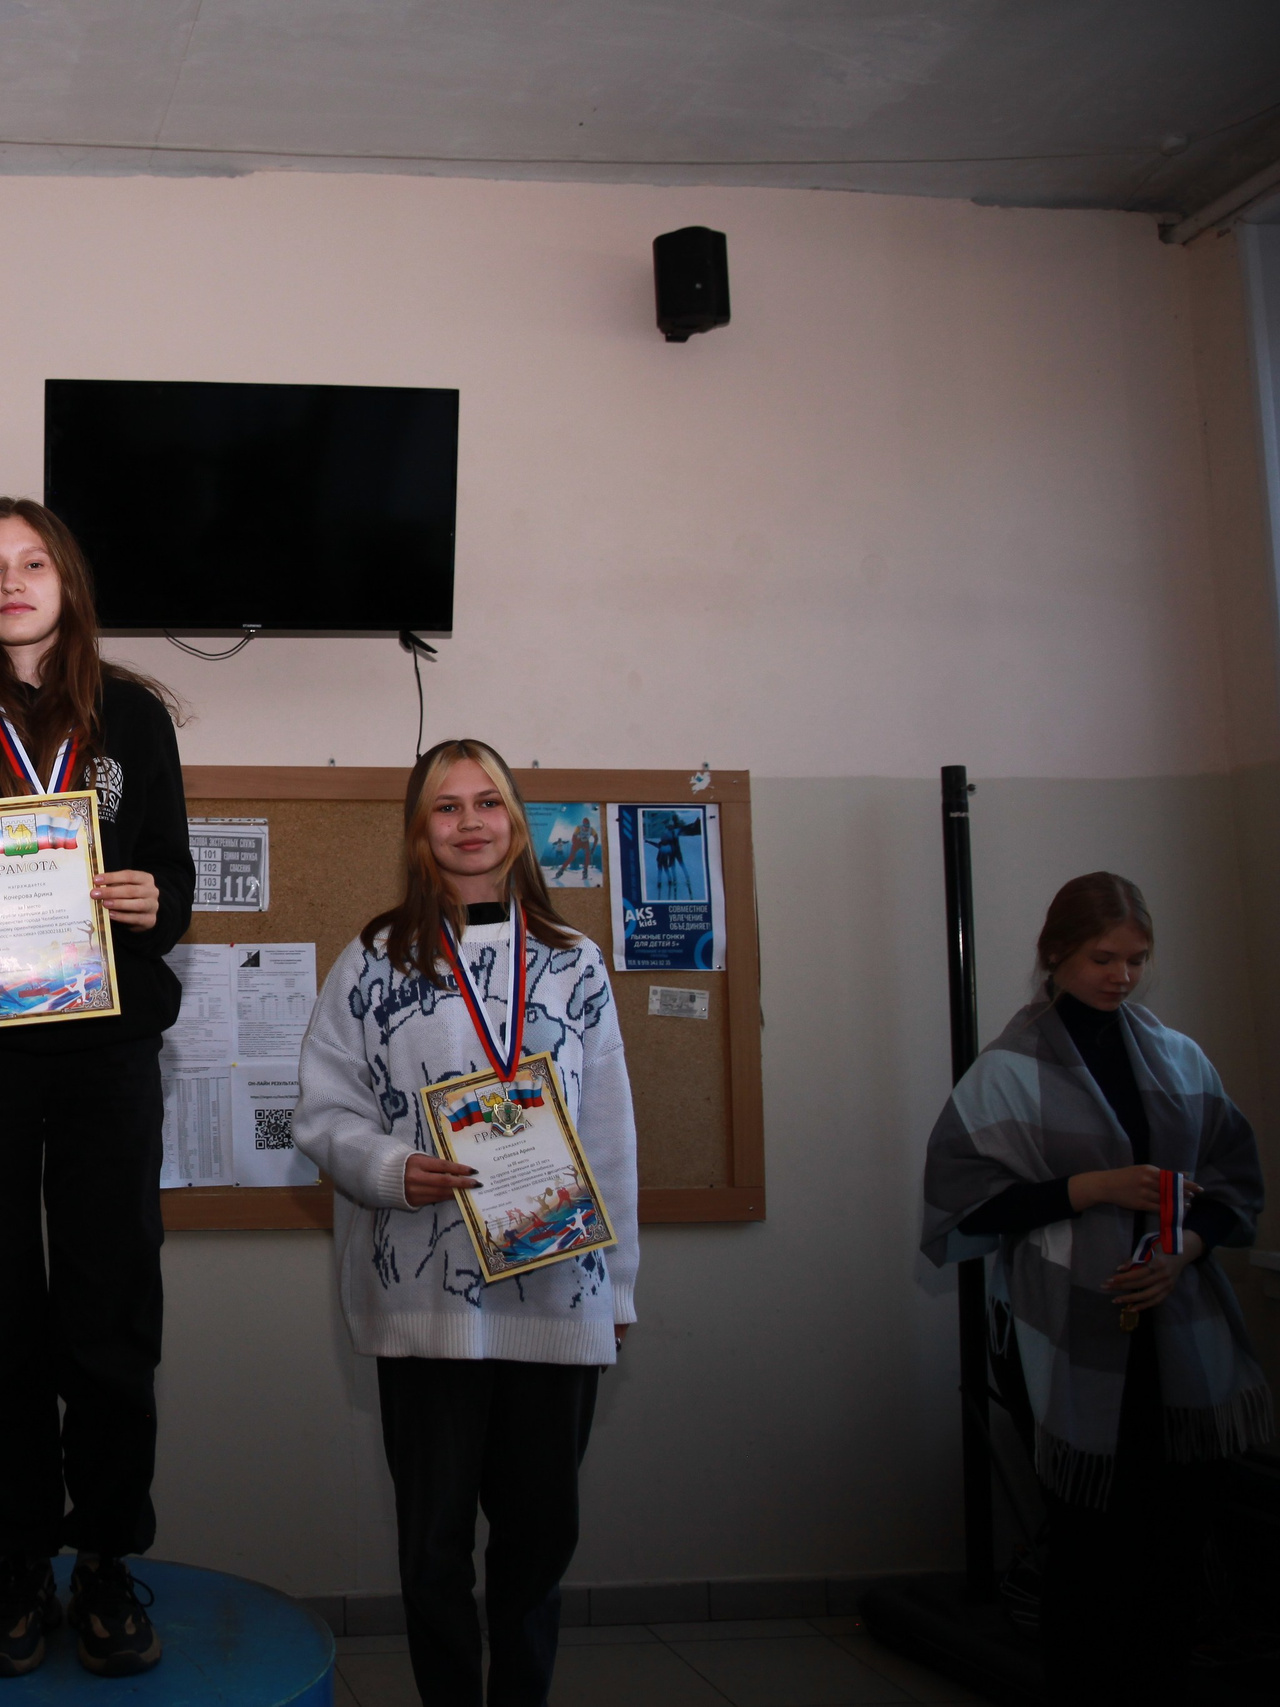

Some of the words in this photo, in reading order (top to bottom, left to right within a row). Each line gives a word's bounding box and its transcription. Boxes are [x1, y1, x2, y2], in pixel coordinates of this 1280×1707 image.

[240, 839, 256, 848] СЛУЖБ
[204, 850, 216, 858] 101
[240, 852, 258, 861] СЛУЖБА
[204, 864, 216, 872] 102
[204, 878, 216, 886] 103
[223, 876, 258, 902] 112
[3, 893, 32, 901] Кочерова
[204, 892, 216, 900] 104
[625, 907, 654, 922] AKS
[639, 920, 656, 928] kids
[474, 1119, 533, 1143] ГРАА
